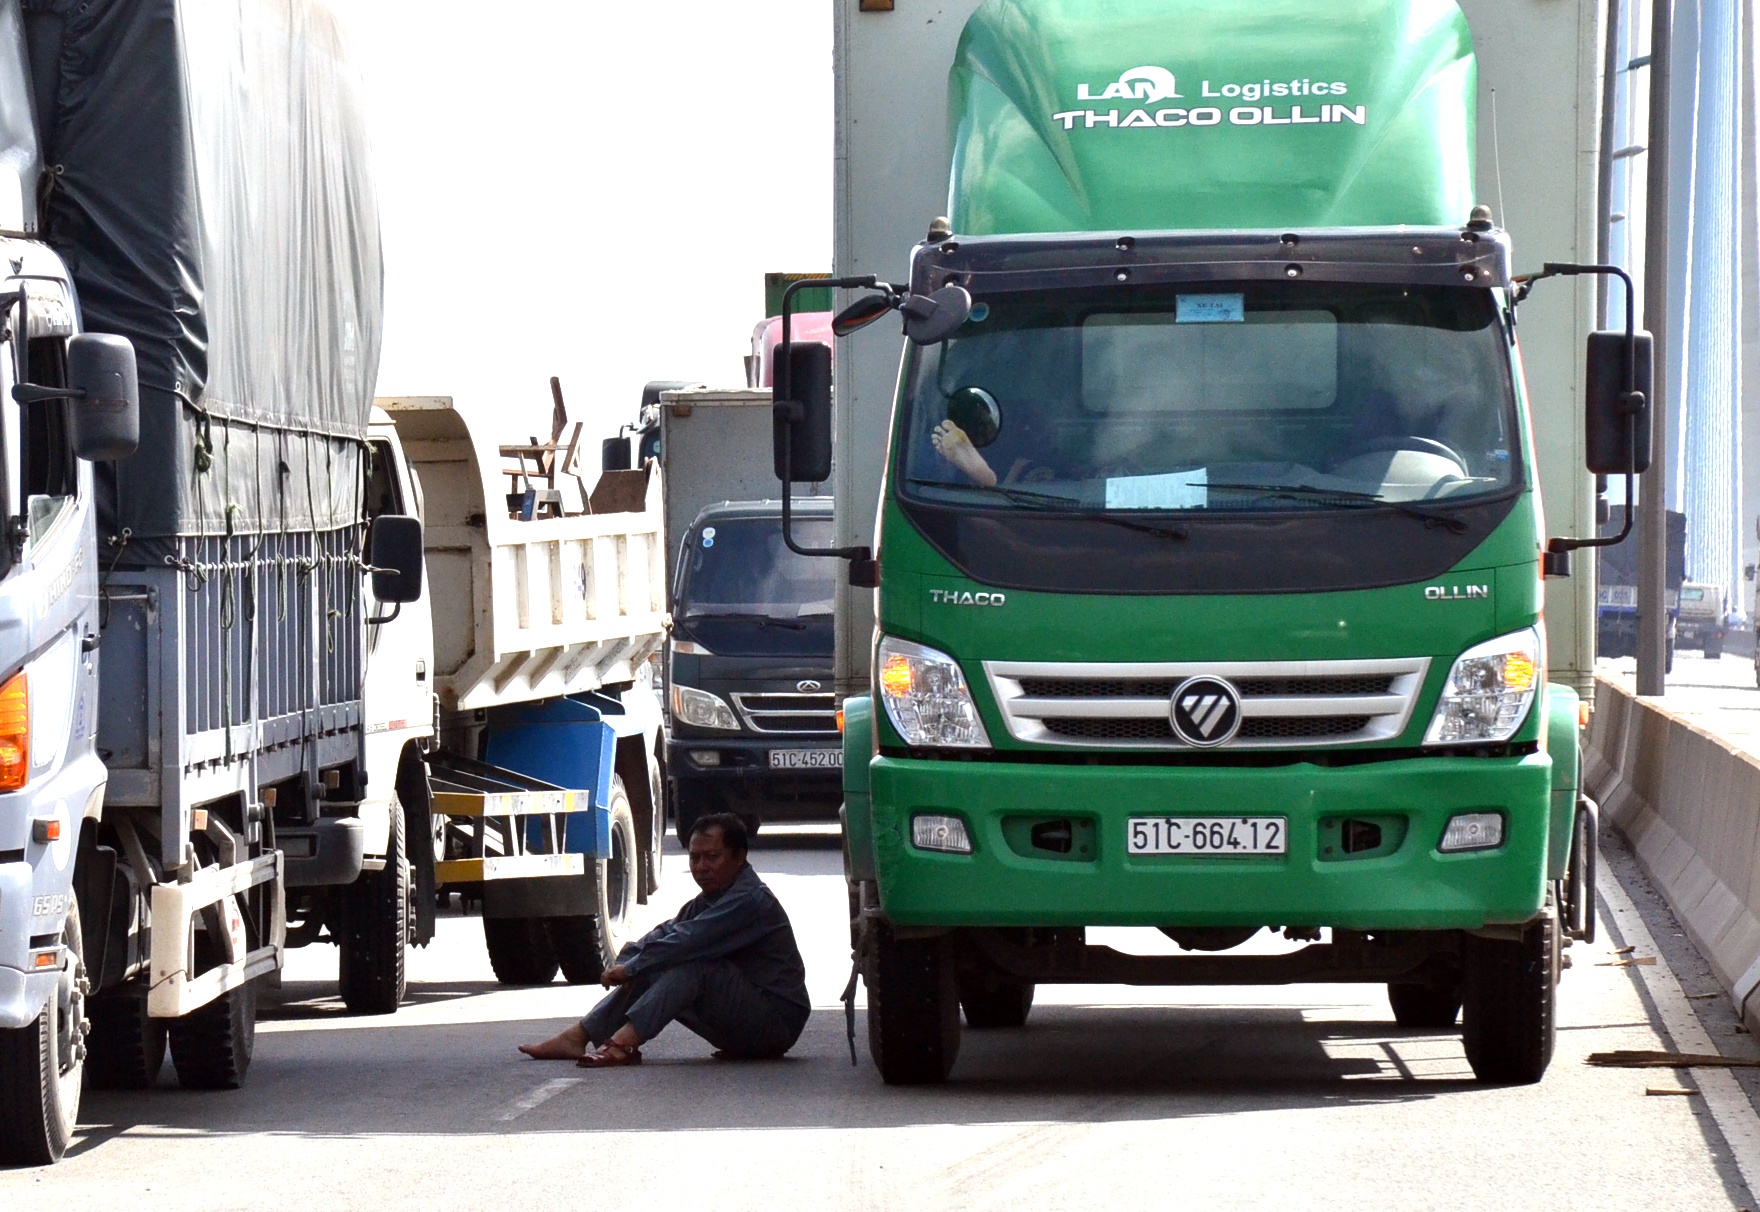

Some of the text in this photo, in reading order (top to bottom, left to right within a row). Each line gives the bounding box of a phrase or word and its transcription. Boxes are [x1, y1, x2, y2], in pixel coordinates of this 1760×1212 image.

[1202, 79, 1347, 101] Logistics
[1053, 103, 1367, 130] THACO OLLIN
[929, 589, 1006, 606] THACO
[1424, 584, 1488, 600] OLLIN
[1133, 821, 1280, 850] 51C-664.12
